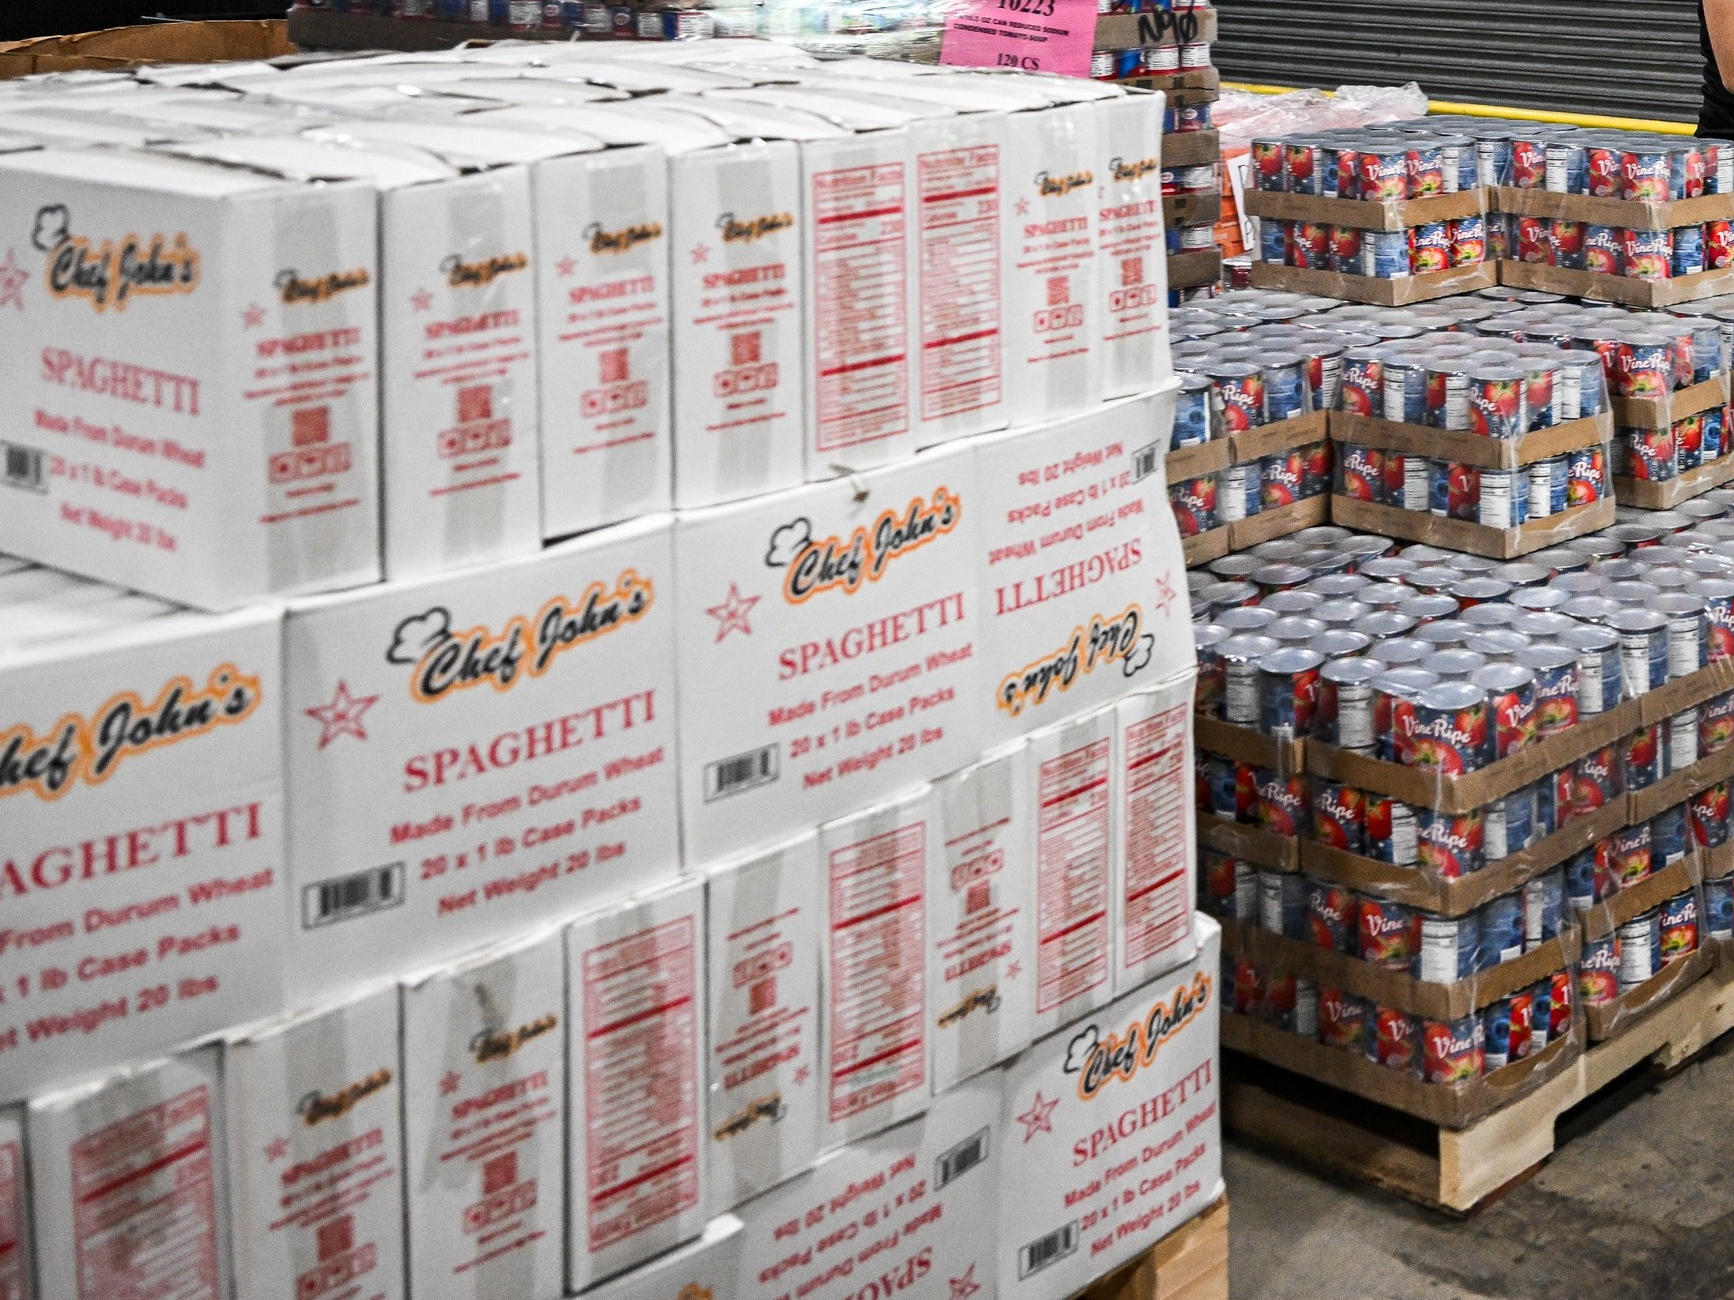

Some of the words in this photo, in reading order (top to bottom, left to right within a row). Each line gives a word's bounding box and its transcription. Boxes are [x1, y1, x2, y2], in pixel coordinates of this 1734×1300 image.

[954, 23, 997, 35] CONDENSED
[999, 29, 1028, 41] TOMATO
[1029, 34, 1048, 42] SOUP
[981, 17, 991, 25] OZ
[993, 18, 1007, 26] CAN
[1009, 21, 1042, 33] REDUCED
[997, 52, 1018, 68] 120
[1021, 56, 1040, 71] CS
[1024, 216, 1088, 238] SPAGHETTI
[52, 245, 111, 305] Chef
[115, 241, 194, 301] John's
[569, 274, 655, 304] SPAGHETTI
[703, 263, 785, 290] SPAGHETTI
[41, 346, 199, 417] SPAGHETTI
[1063, 450, 1103, 474] Weight
[792, 535, 863, 596] Chef
[873, 493, 955, 573] John's
[1008, 501, 1052, 525] Packs
[1040, 523, 1083, 549] Durum
[988, 541, 1036, 566] Wheat
[995, 538, 1143, 617] SPAGHETTI
[421, 626, 524, 696] Chef
[535, 577, 648, 671] John's
[778, 592, 965, 681] SPAGHETTI
[1086, 610, 1139, 669] Chef
[768, 700, 816, 727] Made
[821, 684, 865, 711] From
[869, 663, 921, 694] Durum
[925, 642, 973, 672] Wheat
[1005, 636, 1080, 714] John's
[0, 724, 77, 791] hef
[94, 673, 250, 776] John's
[404, 688, 656, 794] SPAGHETTI
[789, 736, 810, 759] 20
[815, 734, 826, 749] x
[832, 725, 840, 744] 1
[845, 719, 860, 739] lb
[865, 706, 905, 731] Case
[909, 687, 955, 714] Packs
[803, 767, 833, 790] Net
[837, 743, 894, 776] Weight
[897, 733, 917, 755] 20
[920, 726, 944, 746] lbs
[390, 815, 453, 845] Made
[461, 796, 522, 827] From
[528, 771, 599, 807] Durum
[603, 746, 665, 781] Wheat
[0, 801, 262, 897] AGHETTI
[420, 854, 448, 881] 20
[455, 853, 468, 870] x
[477, 842, 487, 864] 1
[494, 837, 516, 859] lb
[522, 819, 576, 849] Case
[581, 796, 642, 828] Packs
[83, 893, 180, 933] Durum
[187, 865, 275, 905] Wheat
[437, 889, 478, 916] Net
[482, 860, 560, 900] Weight
[566, 851, 590, 874] 20
[595, 841, 627, 864] lbs
[40, 967, 69, 992] lb
[76, 948, 148, 982] Case
[155, 923, 241, 959] Packs
[26, 997, 129, 1042] Weight
[137, 984, 171, 1014] 20
[177, 974, 219, 1000] lbs
[1085, 1028, 1138, 1094] Chef
[1147, 976, 1207, 1059] John's
[1072, 1057, 1213, 1168] SPAGHETTI
[1064, 1179, 1102, 1209] Made
[1104, 1156, 1139, 1186] From
[1141, 1128, 1184, 1164] Durum
[1185, 1101, 1217, 1134] Wheat
[1081, 1209, 1098, 1232] 20
[1101, 1204, 1110, 1219] x
[1122, 1187, 1135, 1205] lb
[1139, 1169, 1173, 1196] Case
[1175, 1142, 1207, 1175] Packs
[1090, 1233, 1114, 1257] Net
[1116, 1203, 1165, 1240] Weight
[1167, 1192, 1182, 1213] 20
[1184, 1179, 1201, 1199] lbs
